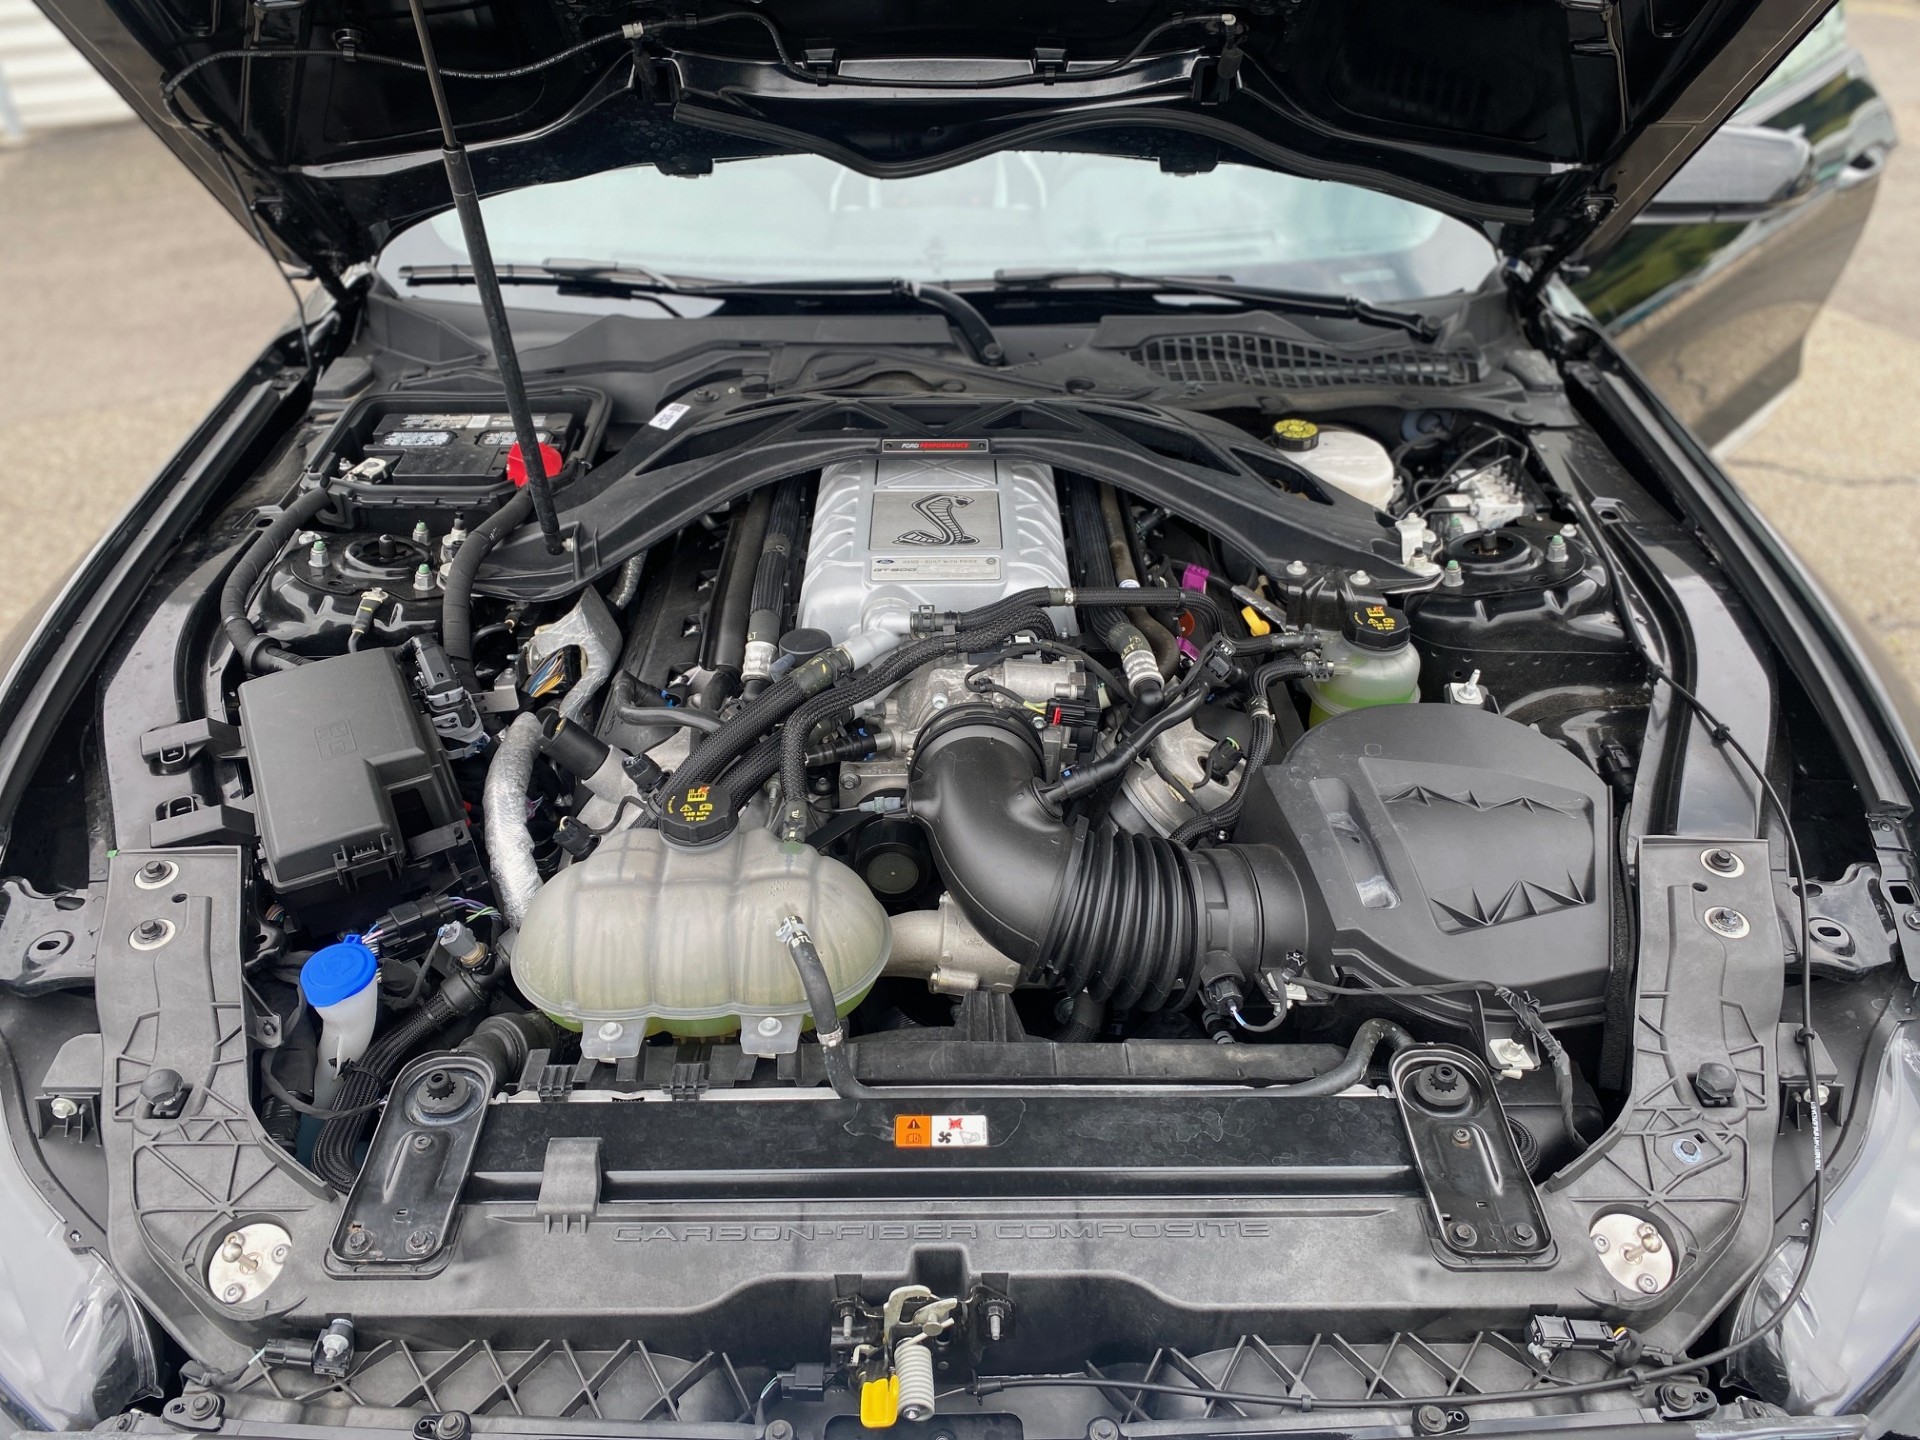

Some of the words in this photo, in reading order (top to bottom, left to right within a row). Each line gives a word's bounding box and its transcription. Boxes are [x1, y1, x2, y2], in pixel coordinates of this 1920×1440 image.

[920, 441, 969, 449] PERFORMANCE
[613, 1223, 977, 1242] CARBON-FIBER
[995, 1221, 1270, 1239] COMPOSITE
